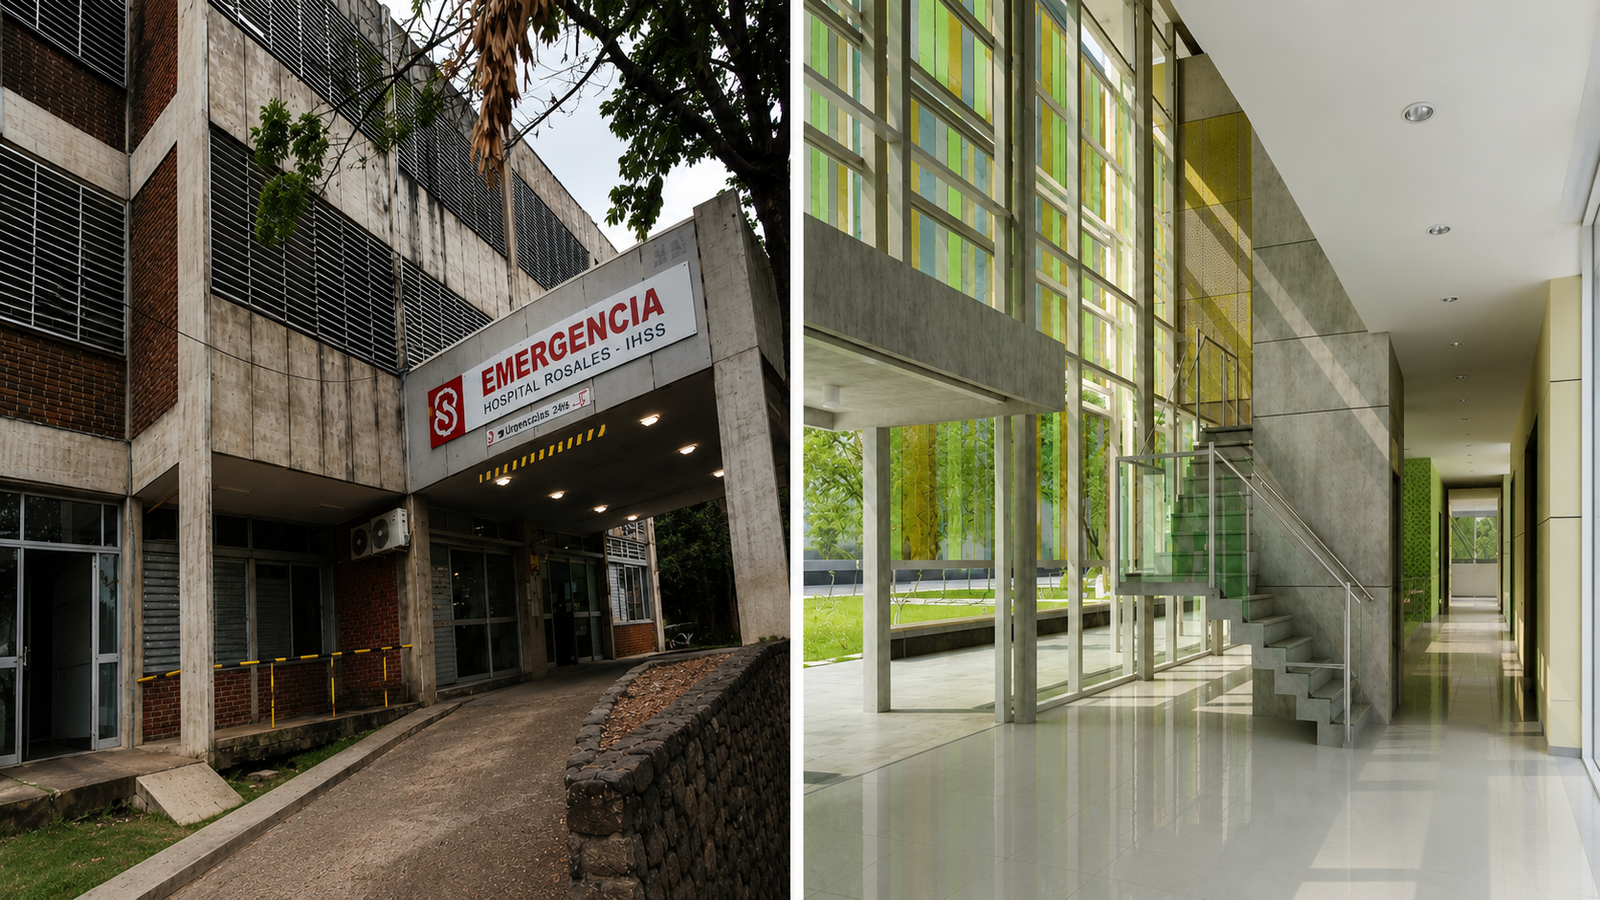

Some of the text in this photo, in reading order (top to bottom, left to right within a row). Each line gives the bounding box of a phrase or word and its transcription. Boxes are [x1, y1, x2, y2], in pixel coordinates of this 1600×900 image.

[481, 287, 665, 397] EMERGENCIA
[483, 380, 540, 415] HOSPITAL
[544, 347, 611, 386] ROSALES
[625, 322, 666, 350] IHSS
